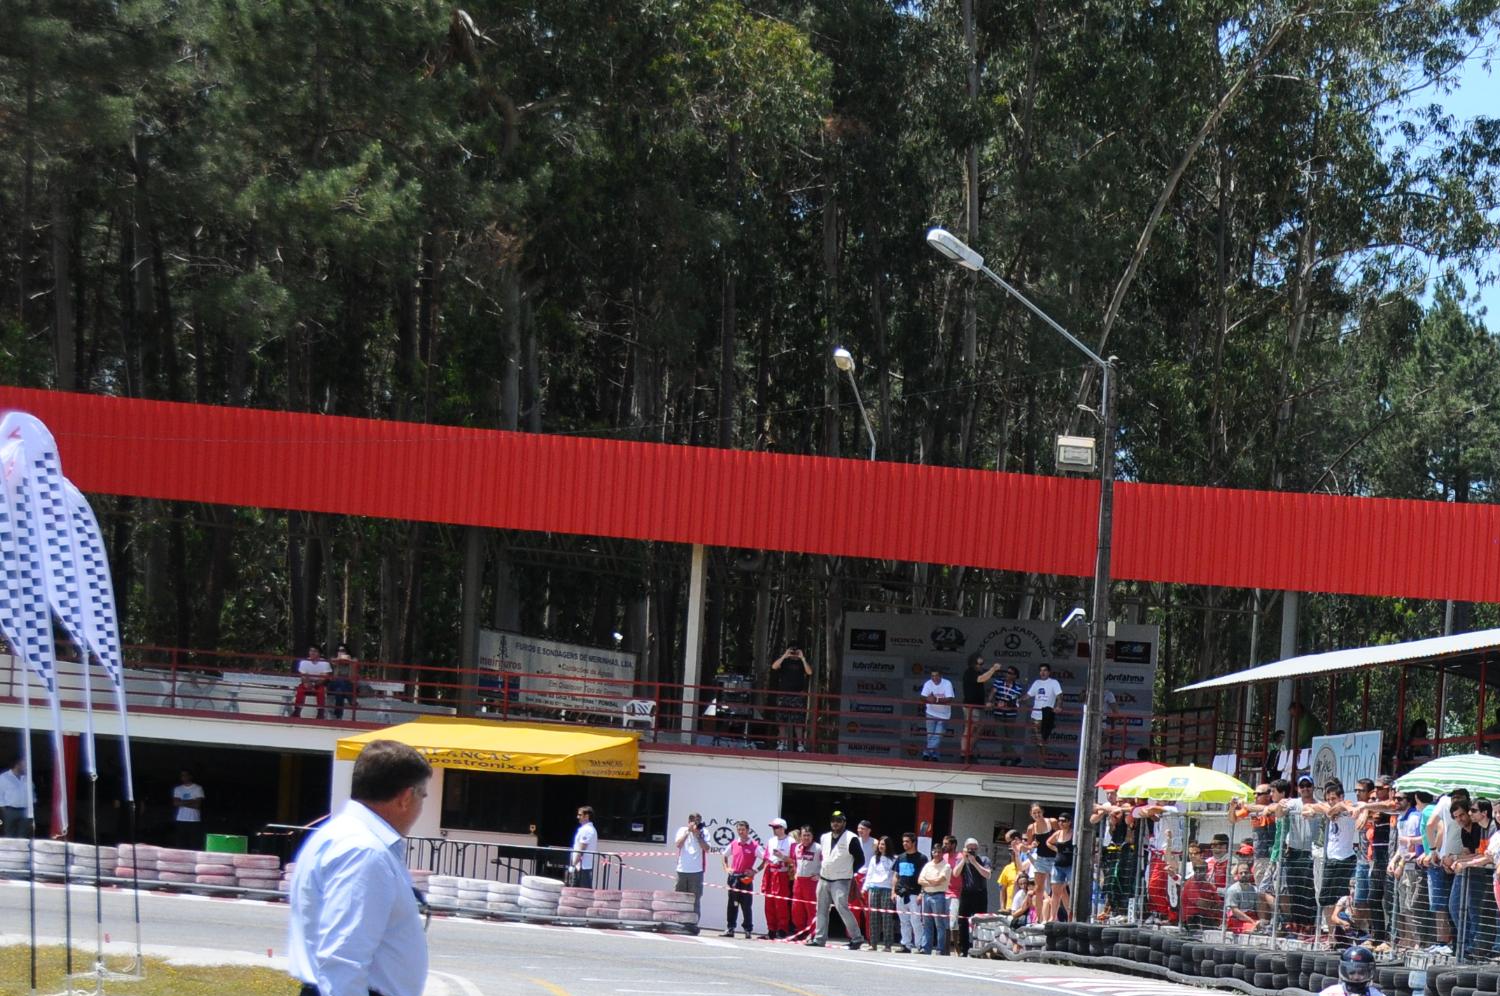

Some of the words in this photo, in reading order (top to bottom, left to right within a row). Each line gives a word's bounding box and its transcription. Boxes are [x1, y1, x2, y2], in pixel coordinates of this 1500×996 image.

[936, 628, 956, 641] 24
[543, 647, 578, 660] SONDAGENS
[579, 654, 588, 662] DE
[429, 758, 541, 773] pestronix.pt
